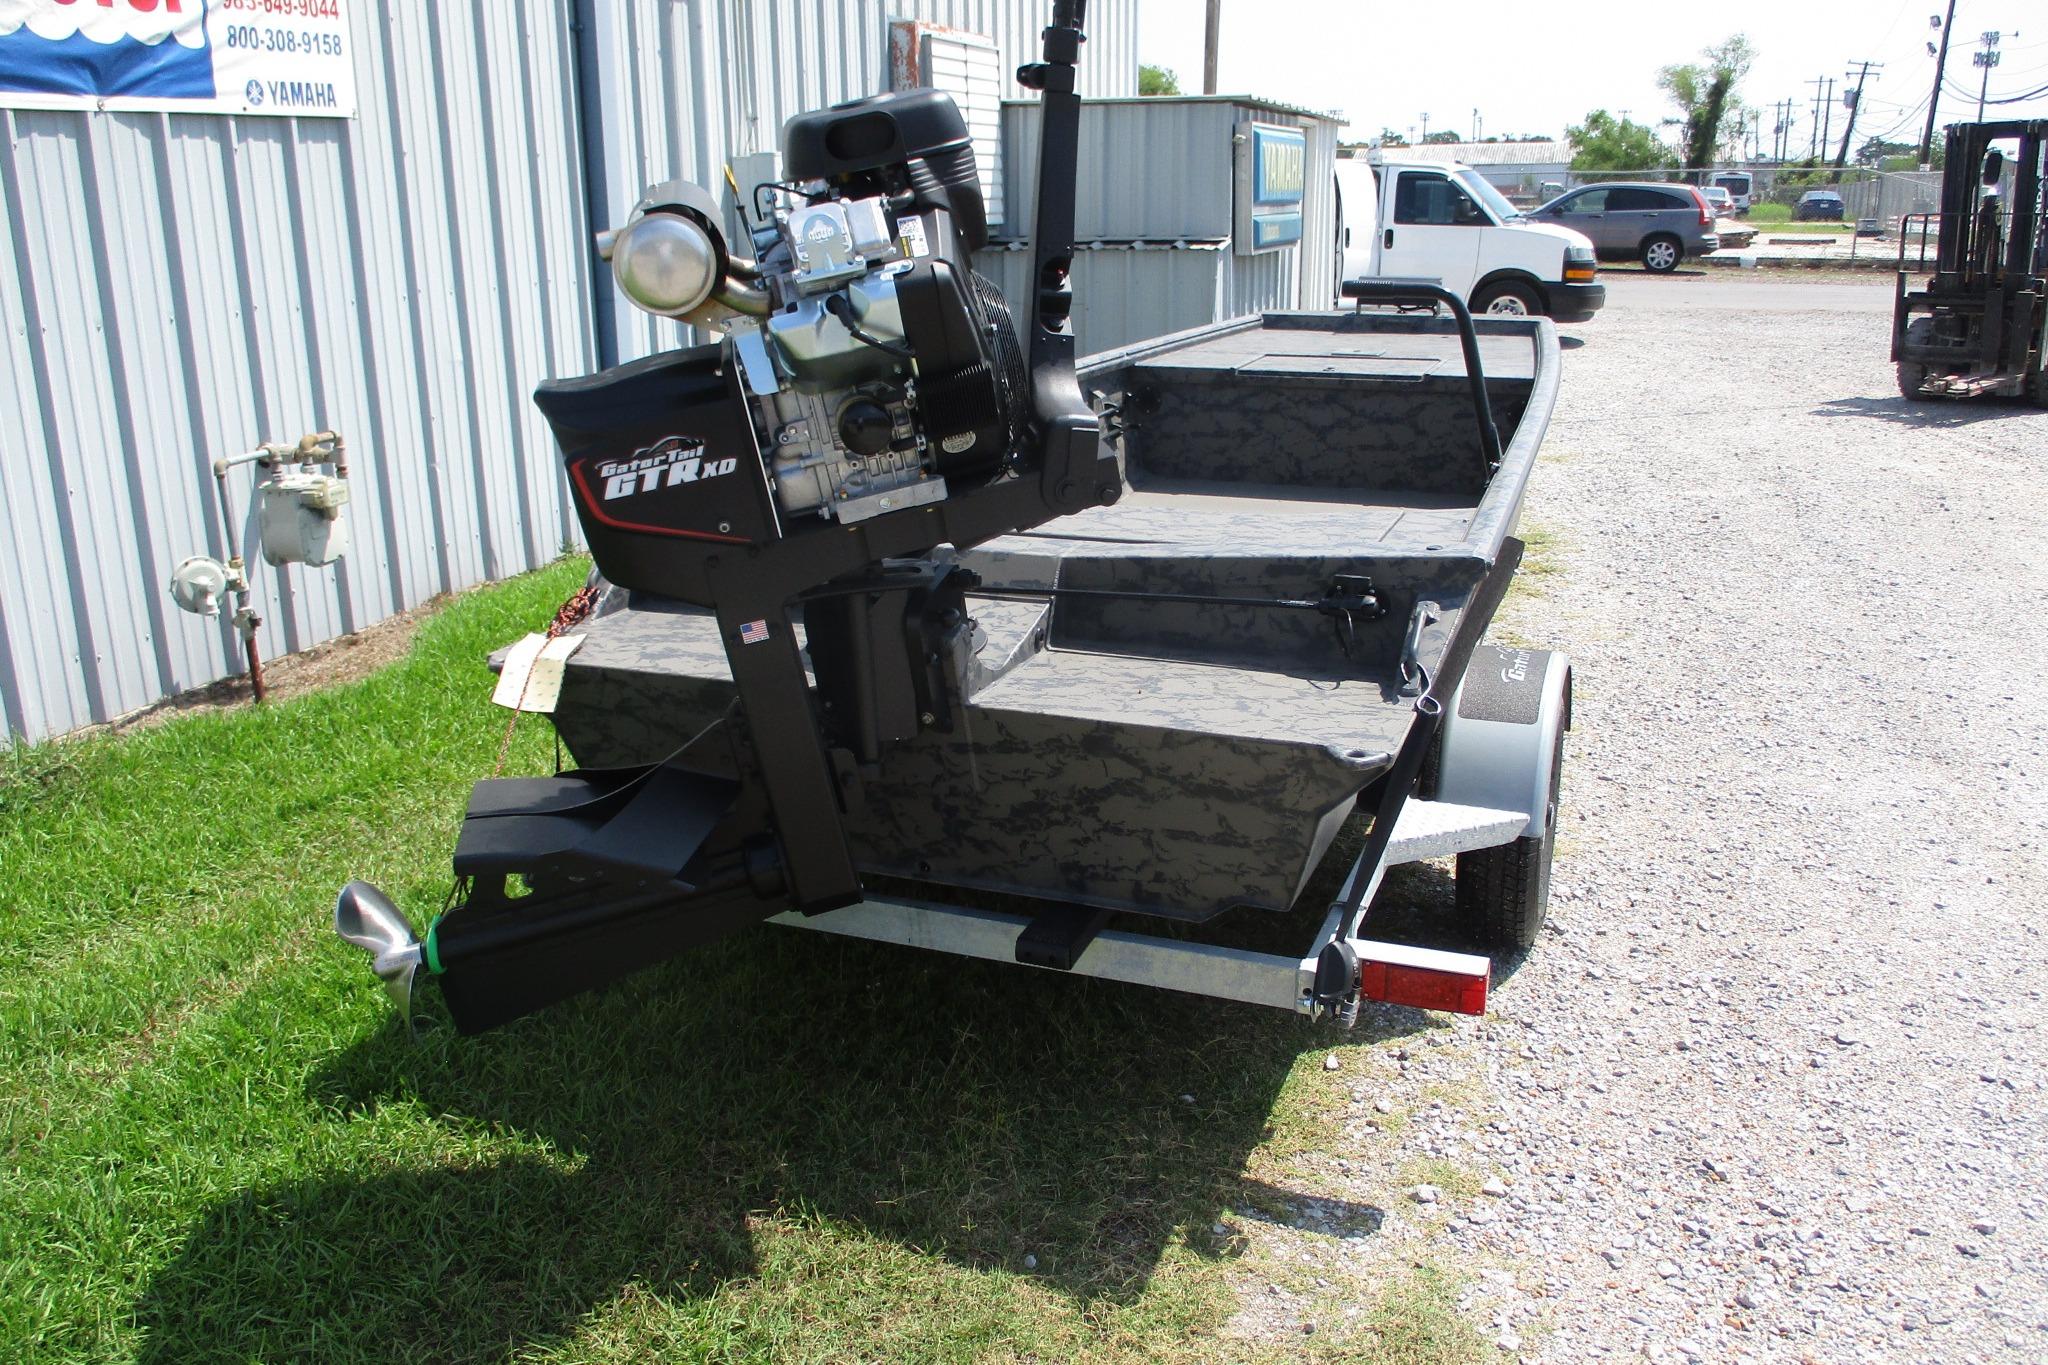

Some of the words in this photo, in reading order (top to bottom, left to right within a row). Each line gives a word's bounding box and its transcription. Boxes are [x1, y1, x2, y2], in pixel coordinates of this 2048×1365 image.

[227, 25, 342, 56] 800-308-9158
[267, 80, 338, 108] YAMAHA
[1263, 141, 1303, 193] YAMAHA
[604, 457, 700, 500] GTR
